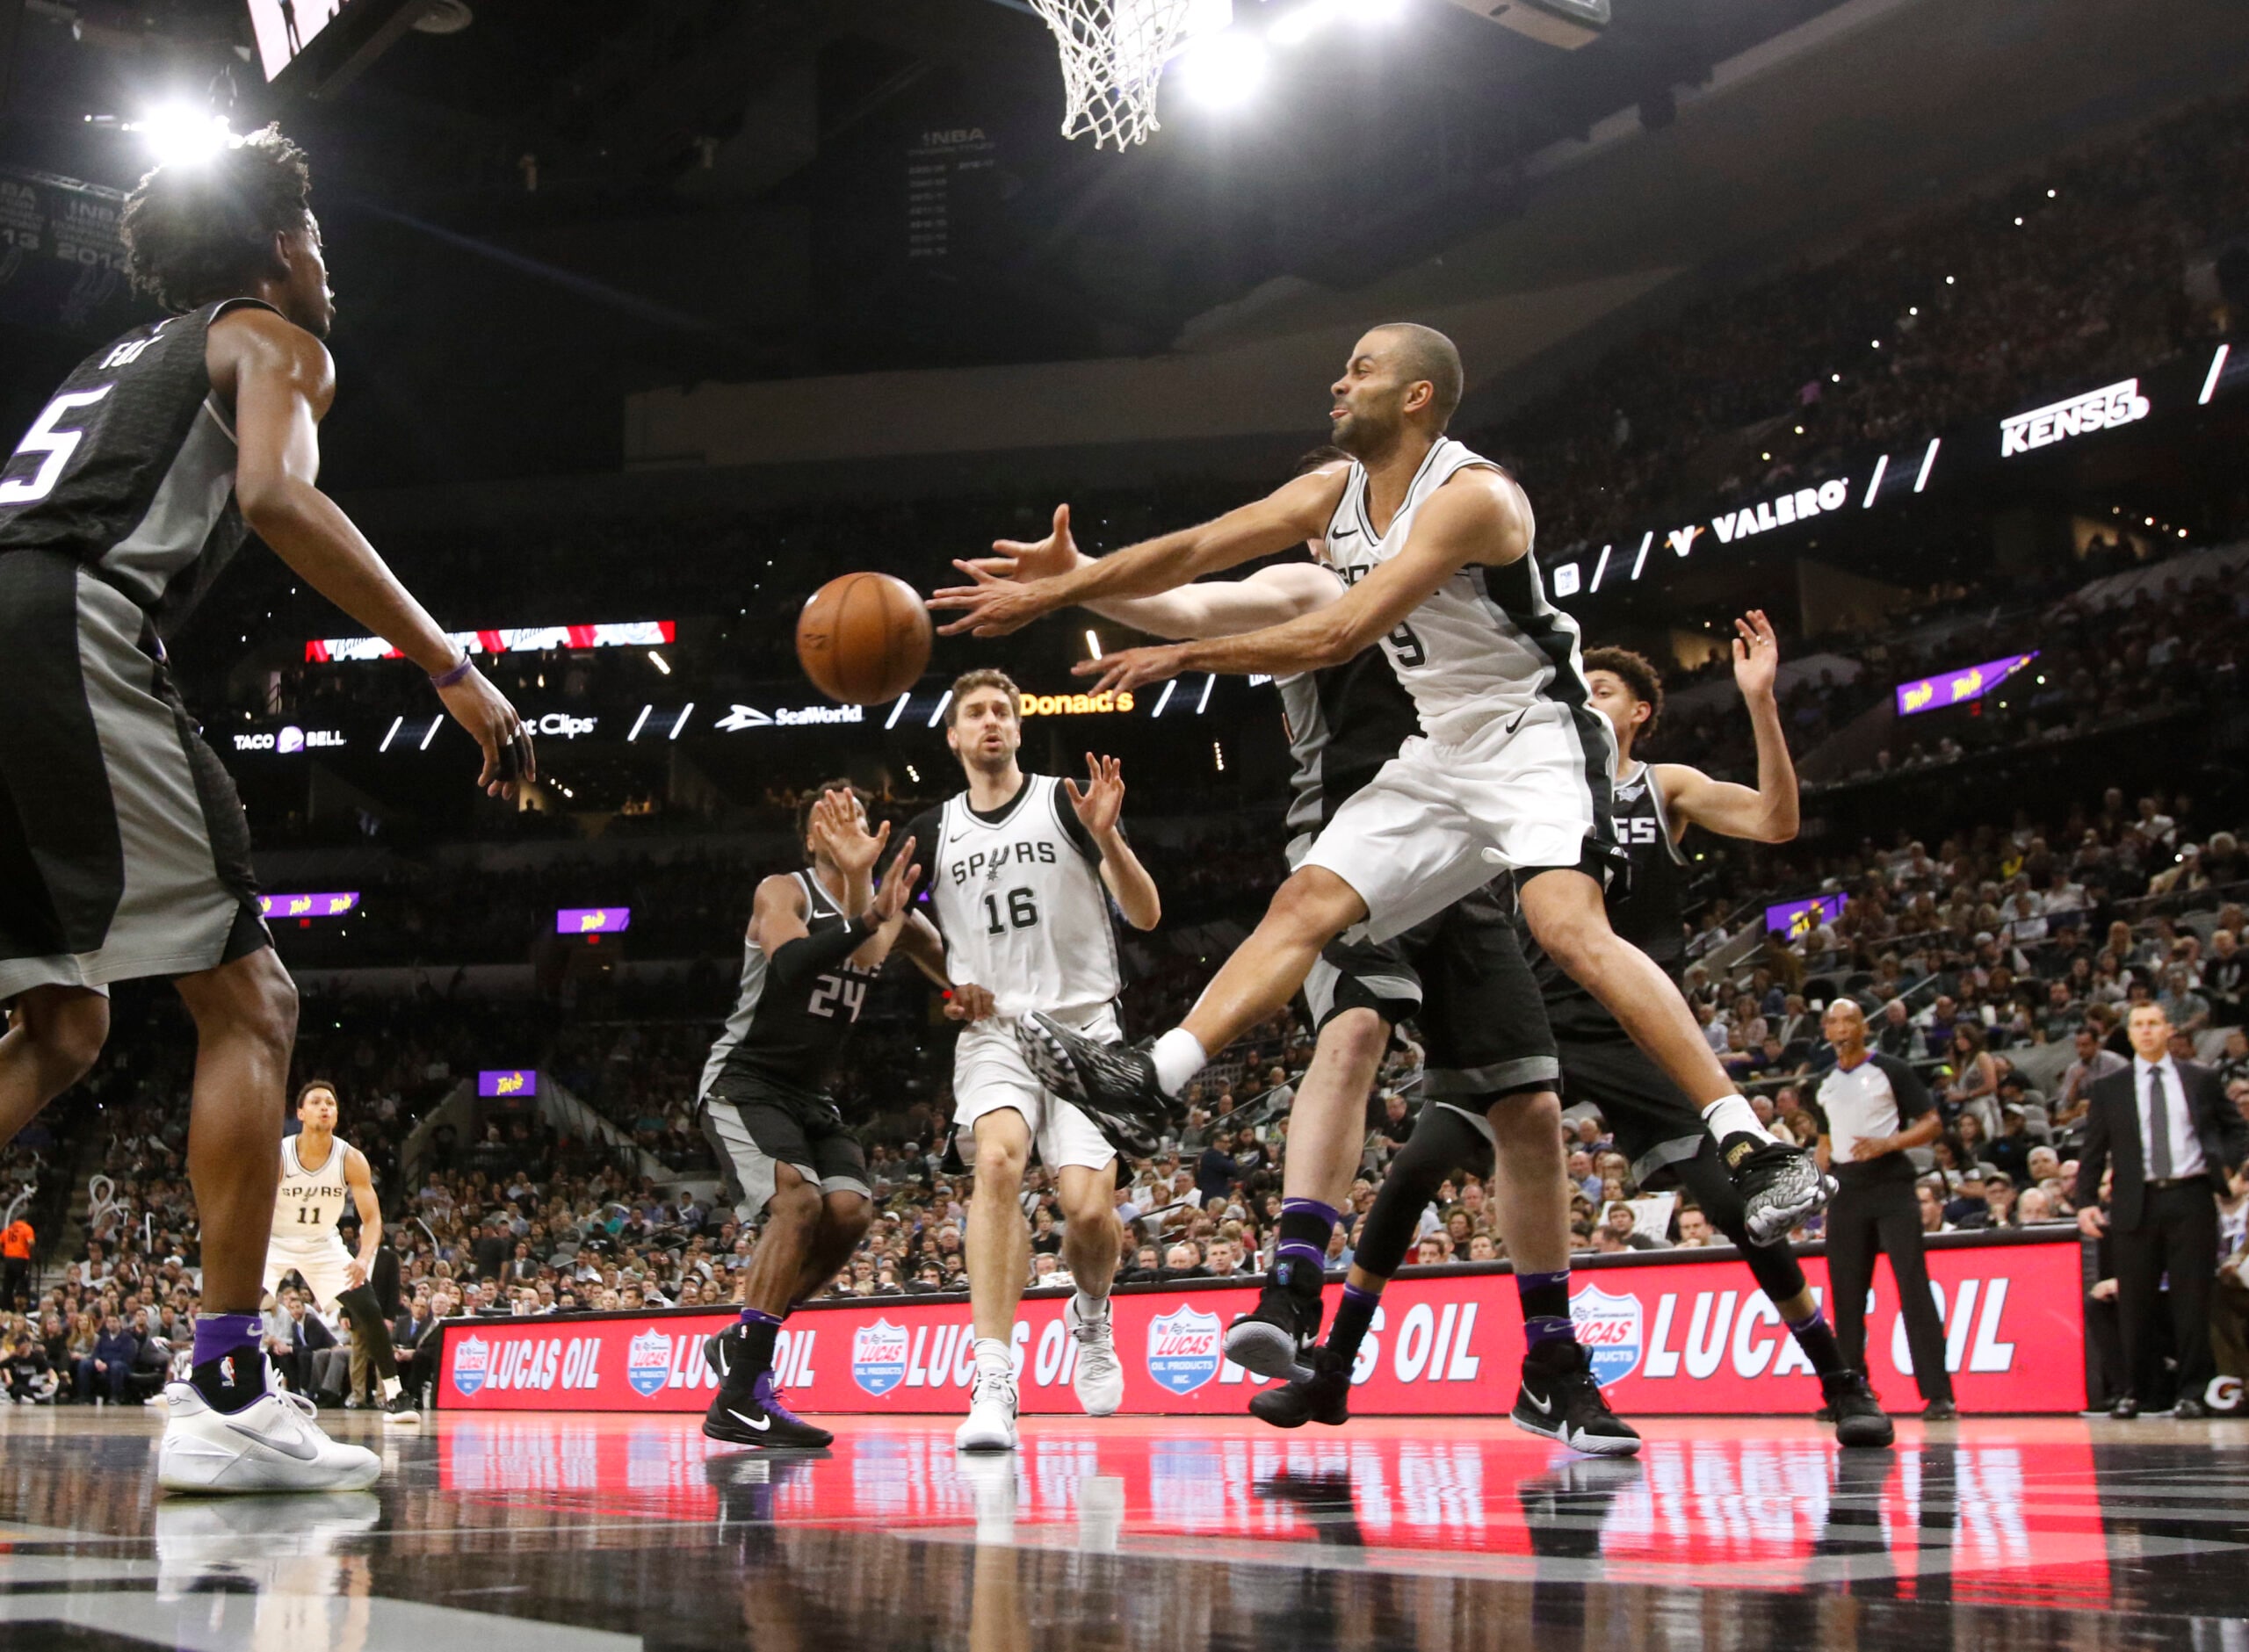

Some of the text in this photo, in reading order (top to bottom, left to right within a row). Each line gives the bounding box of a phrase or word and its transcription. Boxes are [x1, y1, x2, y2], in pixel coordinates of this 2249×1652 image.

[0, 384, 115, 505] 5
[1711, 480, 1847, 544] VALERO
[1388, 620, 1427, 667] 9
[539, 713, 595, 739] Clips
[775, 704, 863, 725] SeaWorld
[234, 731, 345, 750] TACO BELL
[951, 840, 1057, 885] SPURS
[984, 887, 1041, 935] 16
[807, 974, 866, 1023] 24
[281, 1186, 343, 1201] SPURS
[296, 1207, 322, 1224] 11
[859, 1345, 903, 1361] LUCAS
[1035, 1318, 1081, 1387] OI
[1155, 1335, 1214, 1355] LUCAS
[1393, 1302, 1481, 1384] OIL
[1574, 1320, 1632, 1344] UCAS
[1642, 1286, 1876, 1379] LUCA
[485, 1337, 602, 1390] LUCAS OIL
[770, 1330, 817, 1389] OIL
[1151, 1360, 1213, 1371] OIL PRODUCTS
[2204, 1375, 2244, 1410] G
